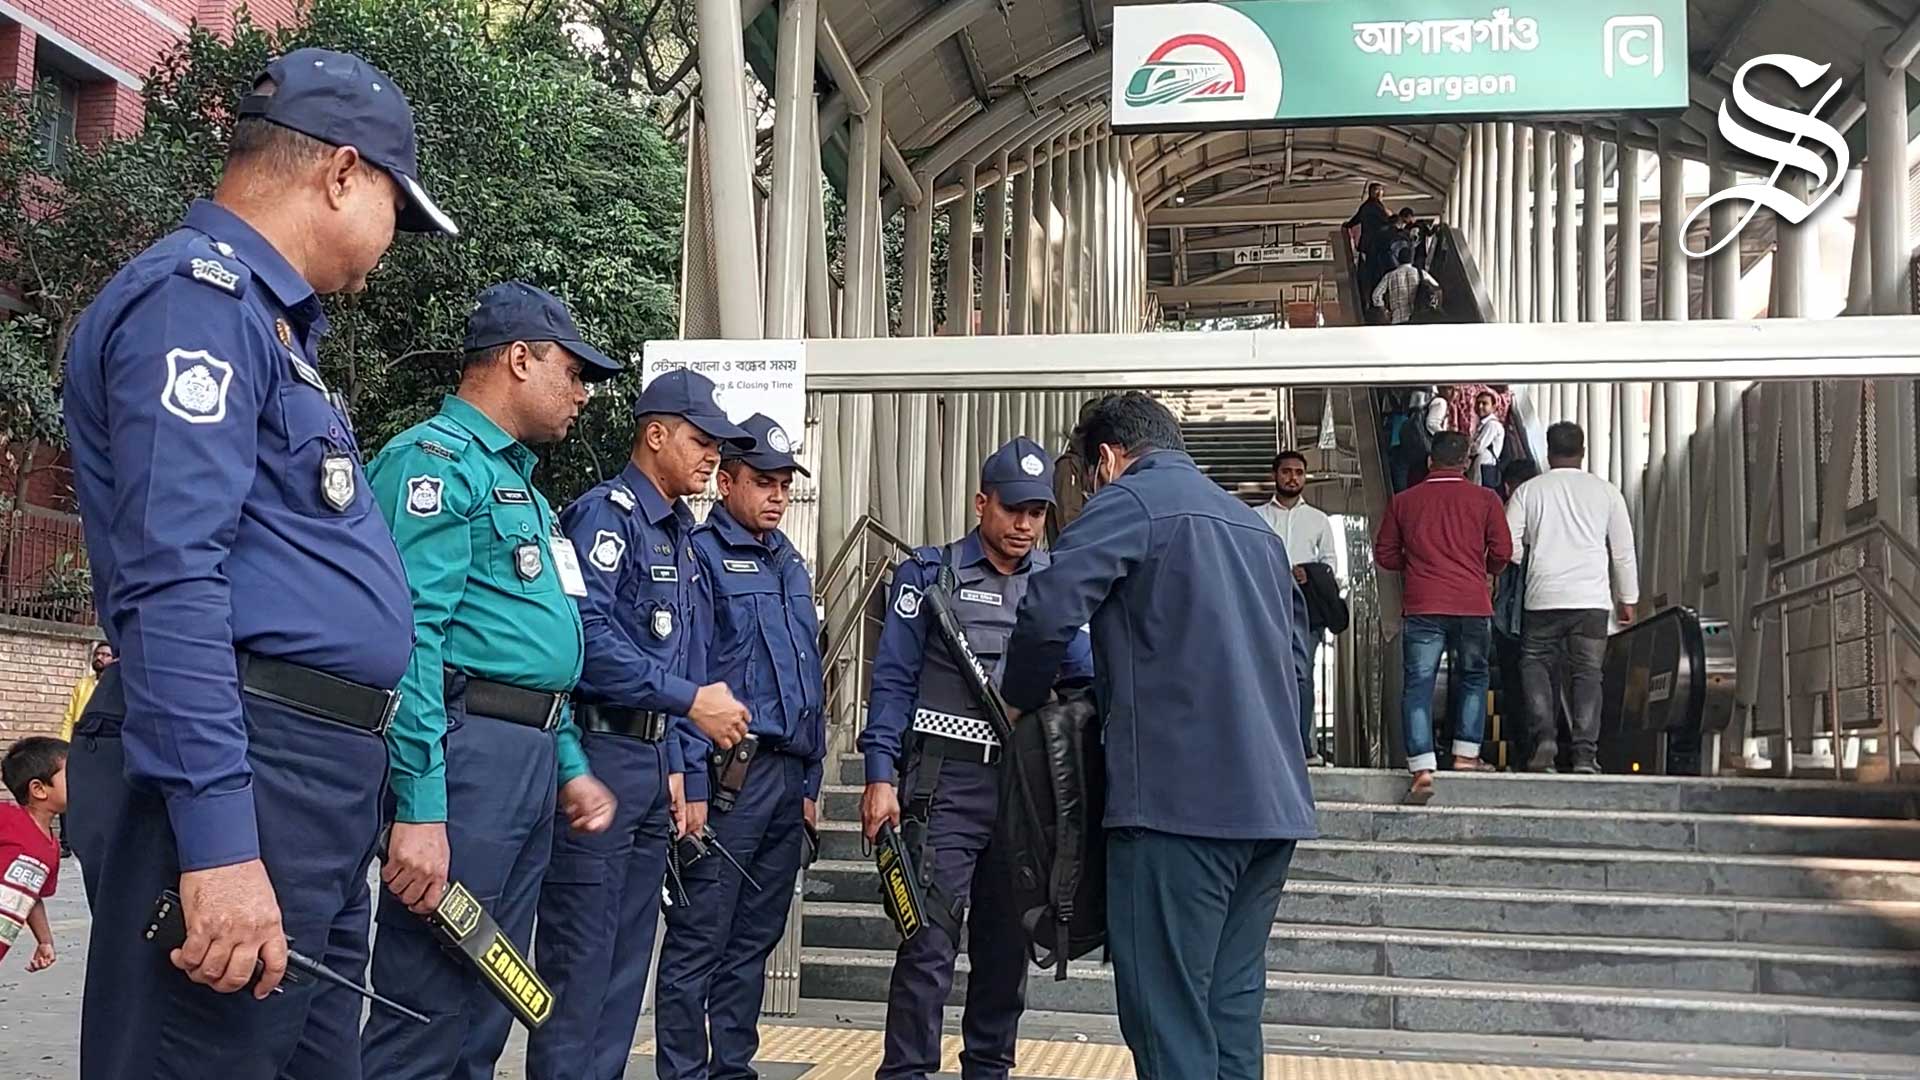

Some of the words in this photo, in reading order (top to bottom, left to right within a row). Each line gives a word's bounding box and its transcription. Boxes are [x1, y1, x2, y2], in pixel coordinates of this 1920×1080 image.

[1353, 8, 1539, 55] আগারগাঁও
[1619, 29, 1649, 66] C
[1376, 72, 1516, 101] Agargaon
[722, 363, 732, 372] ও
[769, 359, 797, 372] সময়
[727, 381, 735, 390] &
[736, 380, 769, 392] Closing
[771, 380, 794, 390] Time
[889, 867, 917, 930] GARRETT
